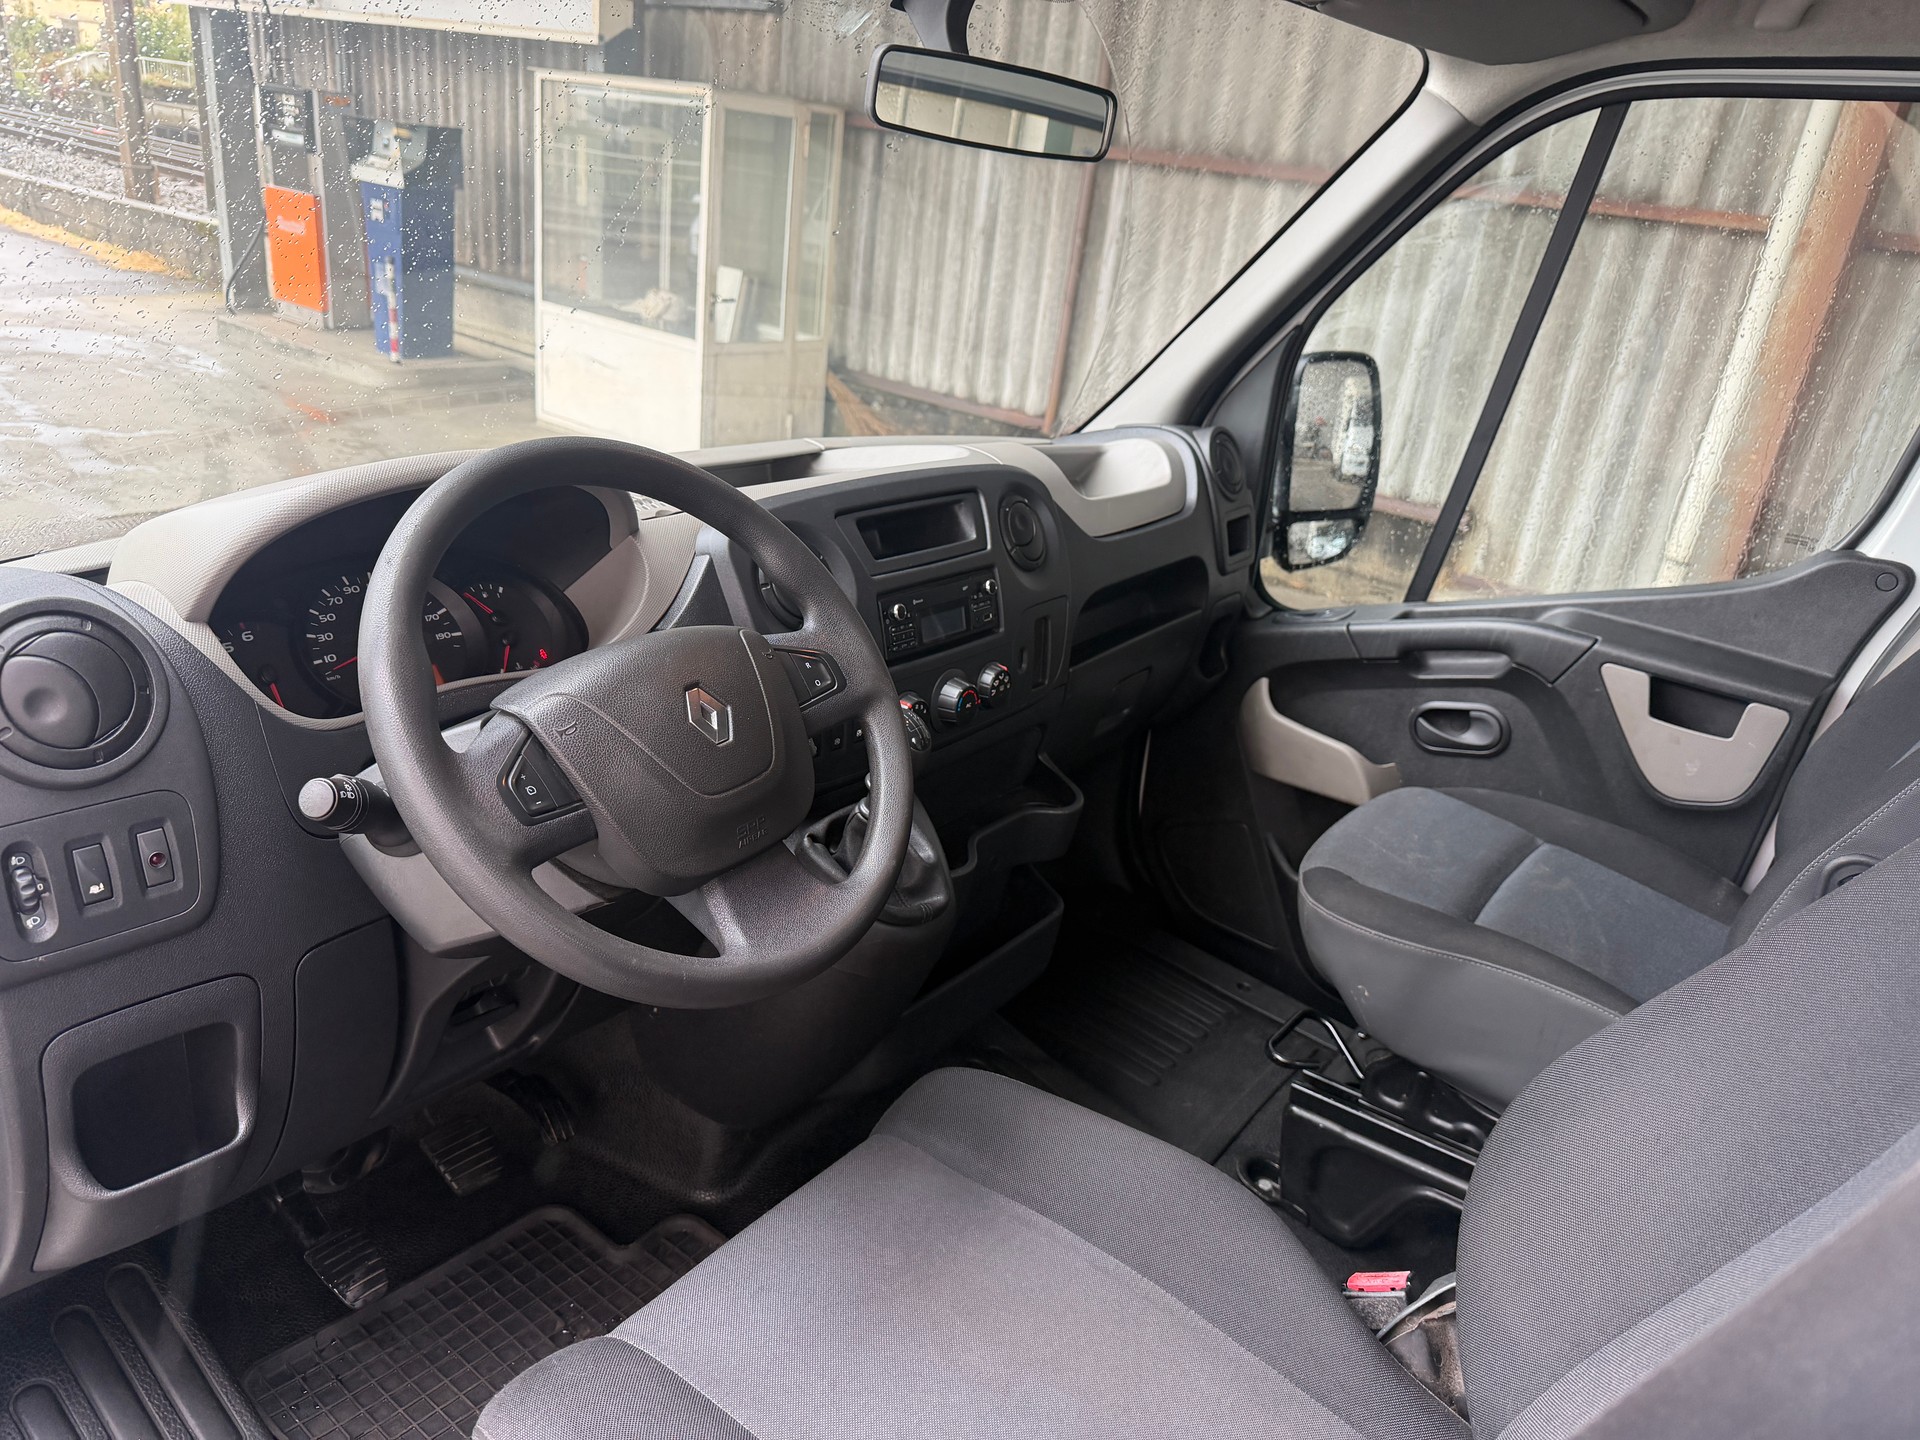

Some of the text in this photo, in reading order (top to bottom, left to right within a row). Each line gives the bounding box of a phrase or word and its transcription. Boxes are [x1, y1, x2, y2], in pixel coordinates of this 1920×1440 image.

[343, 585, 360, 595] 90
[327, 597, 343, 606] 70
[319, 613, 336, 623] 50
[425, 613, 440, 622] 170
[241, 630, 254, 642] 6
[317, 632, 334, 642] 30
[435, 632, 451, 640] 190
[222, 642, 235, 653] 5
[324, 654, 337, 663] 10
[805, 661, 812, 669] R
